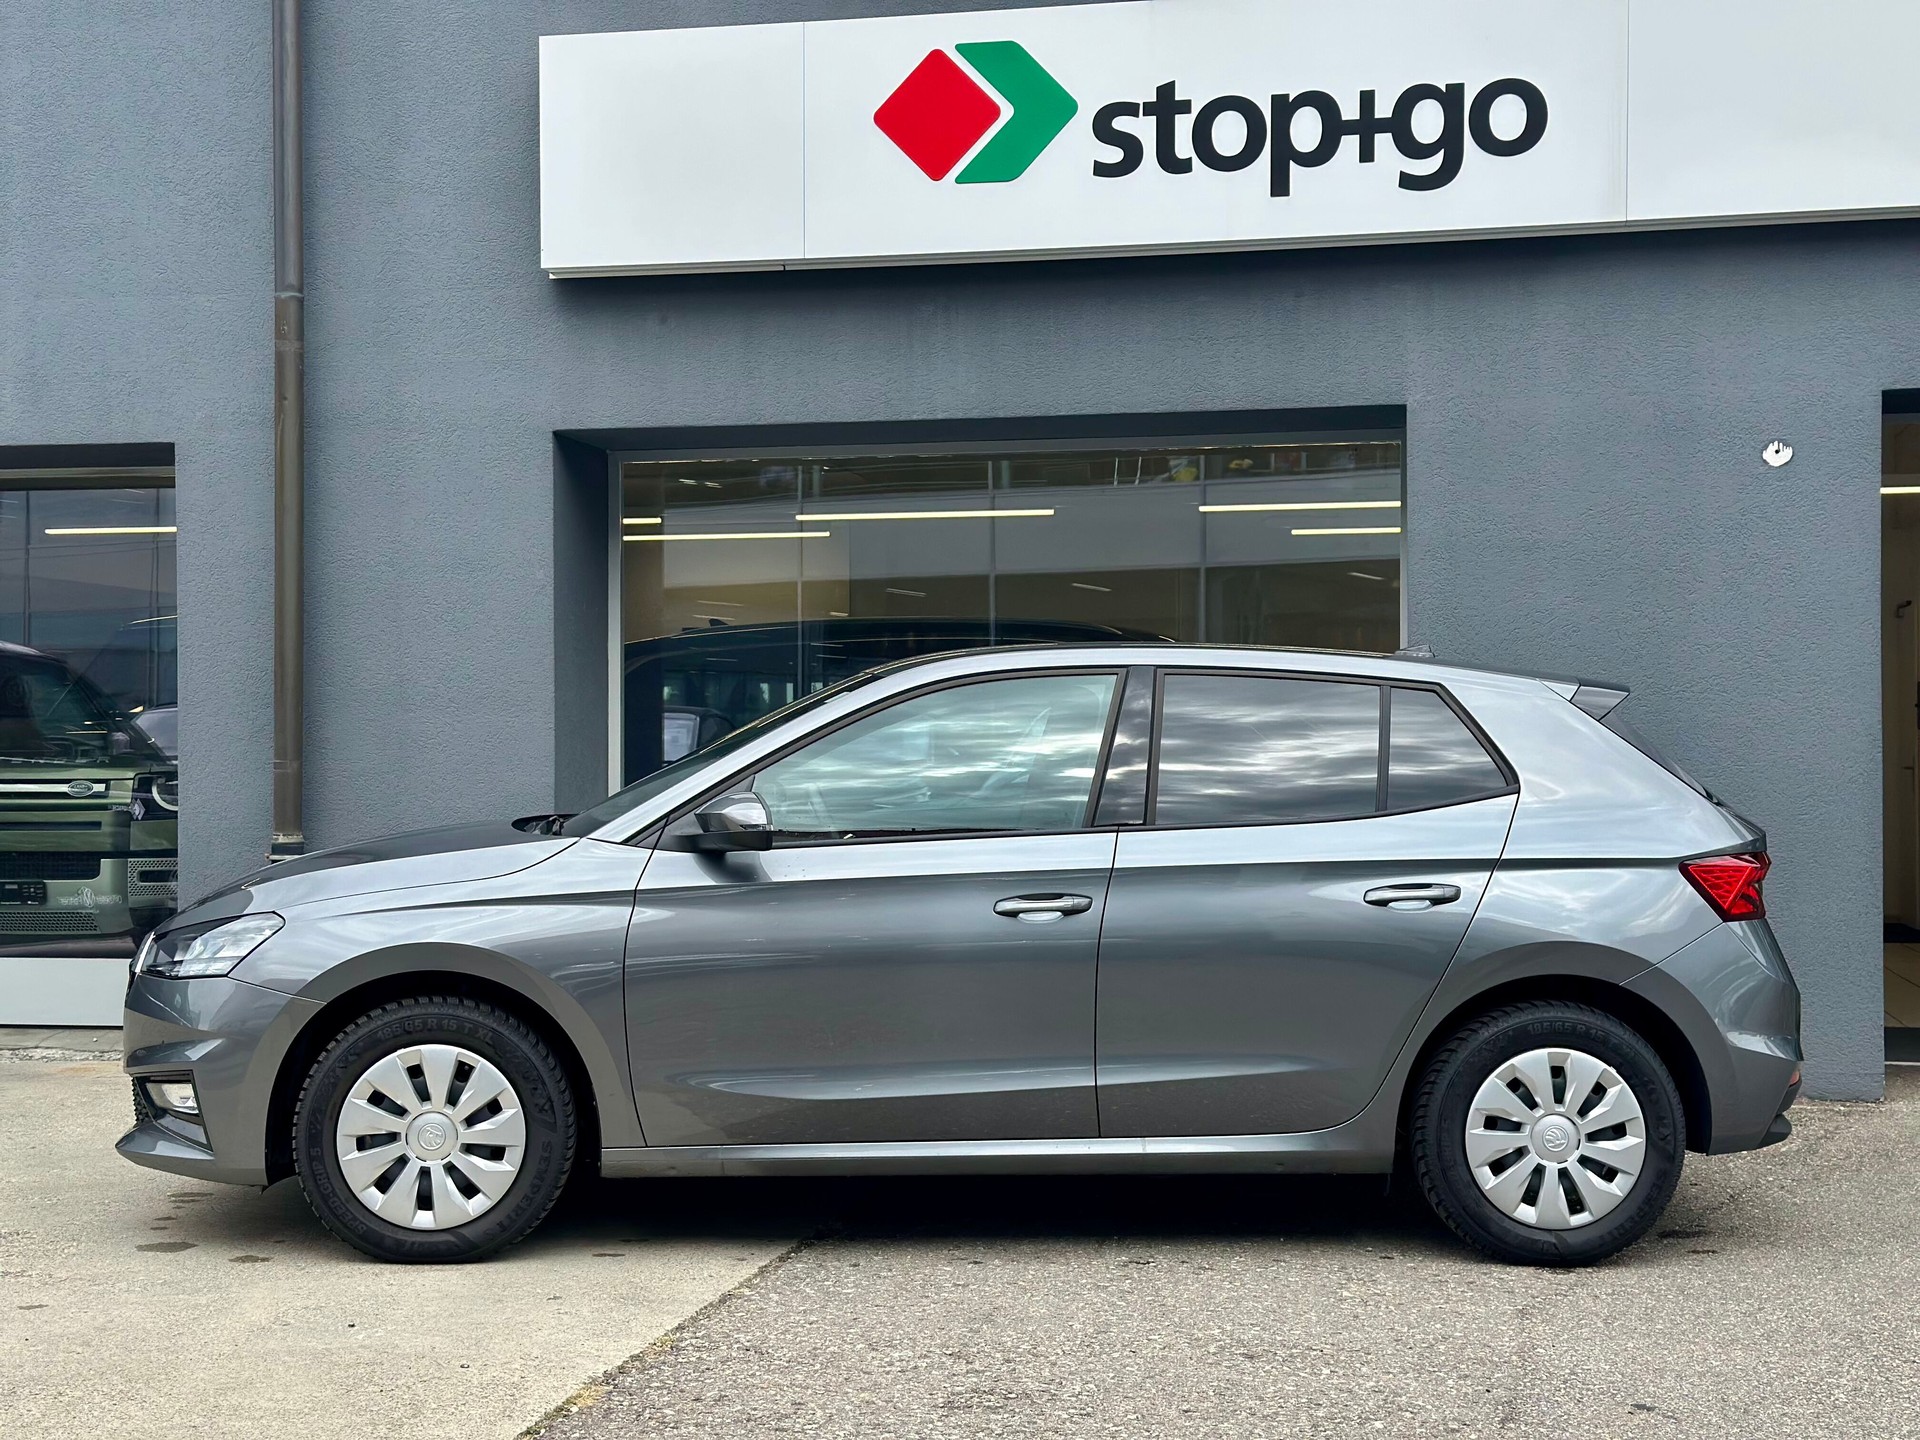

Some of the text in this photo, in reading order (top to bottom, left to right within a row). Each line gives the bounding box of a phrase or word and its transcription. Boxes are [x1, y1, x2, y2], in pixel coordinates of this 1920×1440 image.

[1092, 78, 1548, 197] stop+go
[427, 1018, 437, 1029] R
[442, 1019, 457, 1031] 15
[461, 1022, 473, 1035] T
